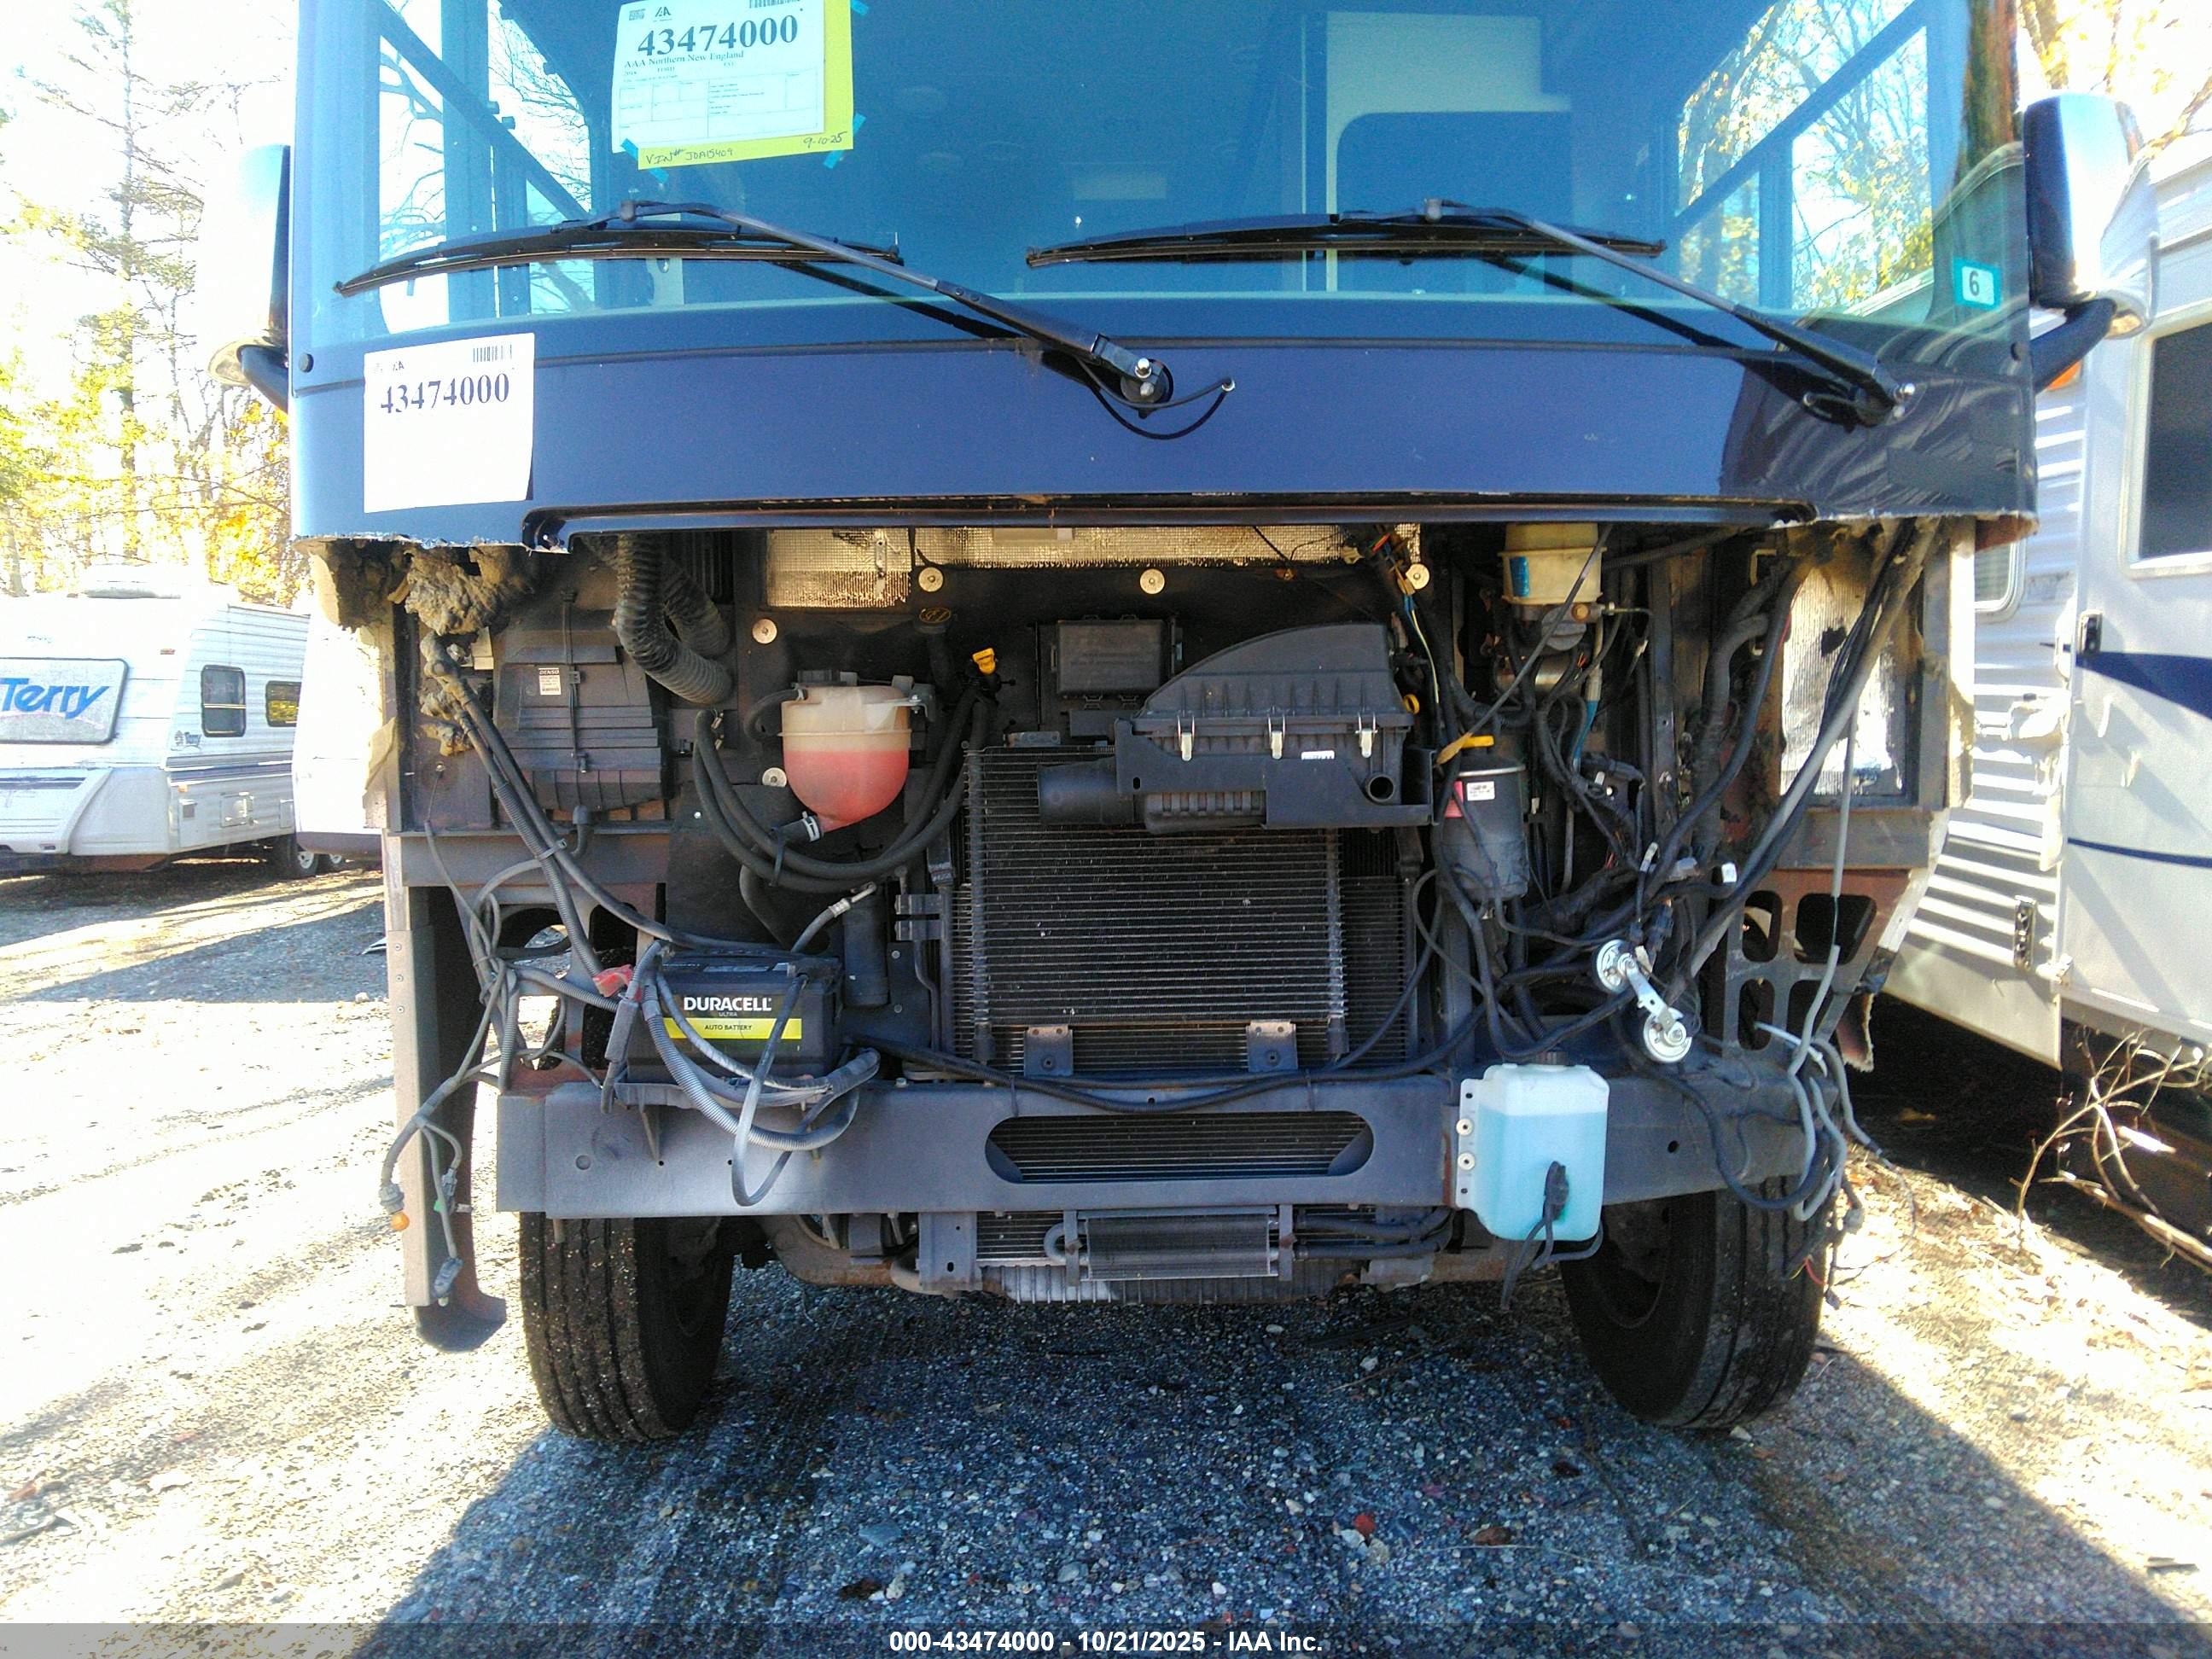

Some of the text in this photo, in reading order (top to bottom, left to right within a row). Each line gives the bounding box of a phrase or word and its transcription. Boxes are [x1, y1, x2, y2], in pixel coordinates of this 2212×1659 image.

[637, 15, 798, 56] 43474000
[624, 50, 744, 68] AAA Northern New England
[1969, 270, 1980, 297] 6
[381, 372, 509, 414] 43474000
[0, 677, 110, 720] Terry
[684, 996, 772, 1012] DURACELL
